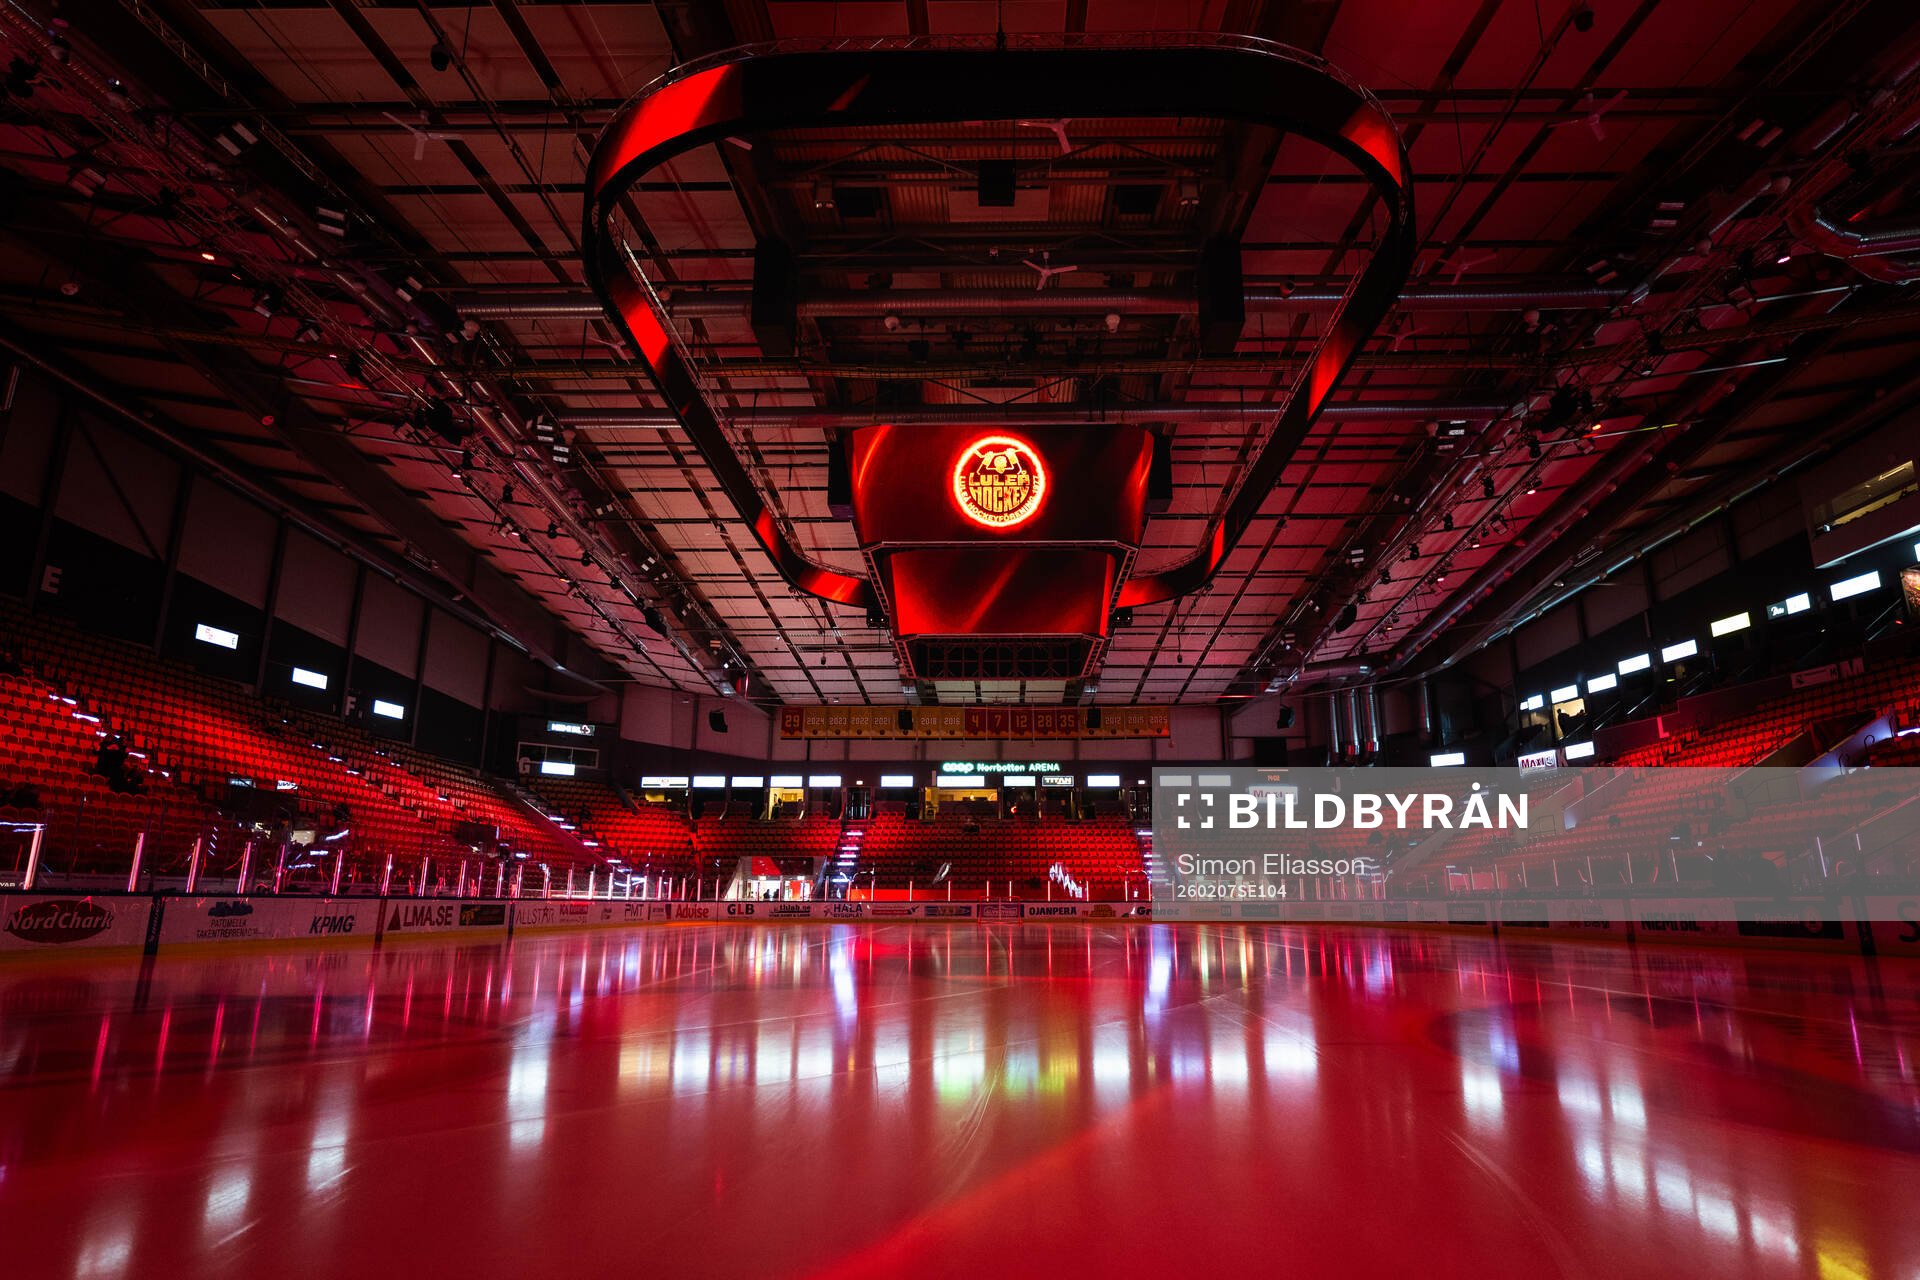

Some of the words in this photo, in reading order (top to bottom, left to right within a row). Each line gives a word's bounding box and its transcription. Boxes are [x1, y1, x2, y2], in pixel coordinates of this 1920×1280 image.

[969, 470, 1030, 486] LULEÅ
[970, 486, 1030, 512] HOCKEY
[41, 564, 62, 594] E
[345, 696, 357, 716] F
[785, 714, 800, 728] 29
[971, 714, 979, 728] 4
[994, 714, 1001, 728] 7
[1015, 714, 1027, 728] 12
[1037, 714, 1052, 728] 28
[1060, 714, 1075, 728] 35
[1656, 716, 1670, 739] L
[518, 757, 531, 775] G
[977, 764, 1025, 772] Norrbotten
[1028, 764, 1061, 772] ARENA
[1044, 777, 1072, 785] TITAN
[675, 905, 709, 919] Advise
[727, 904, 755, 915] GLB
[4, 911, 114, 931] NordChark
[309, 915, 356, 934] KPMG
